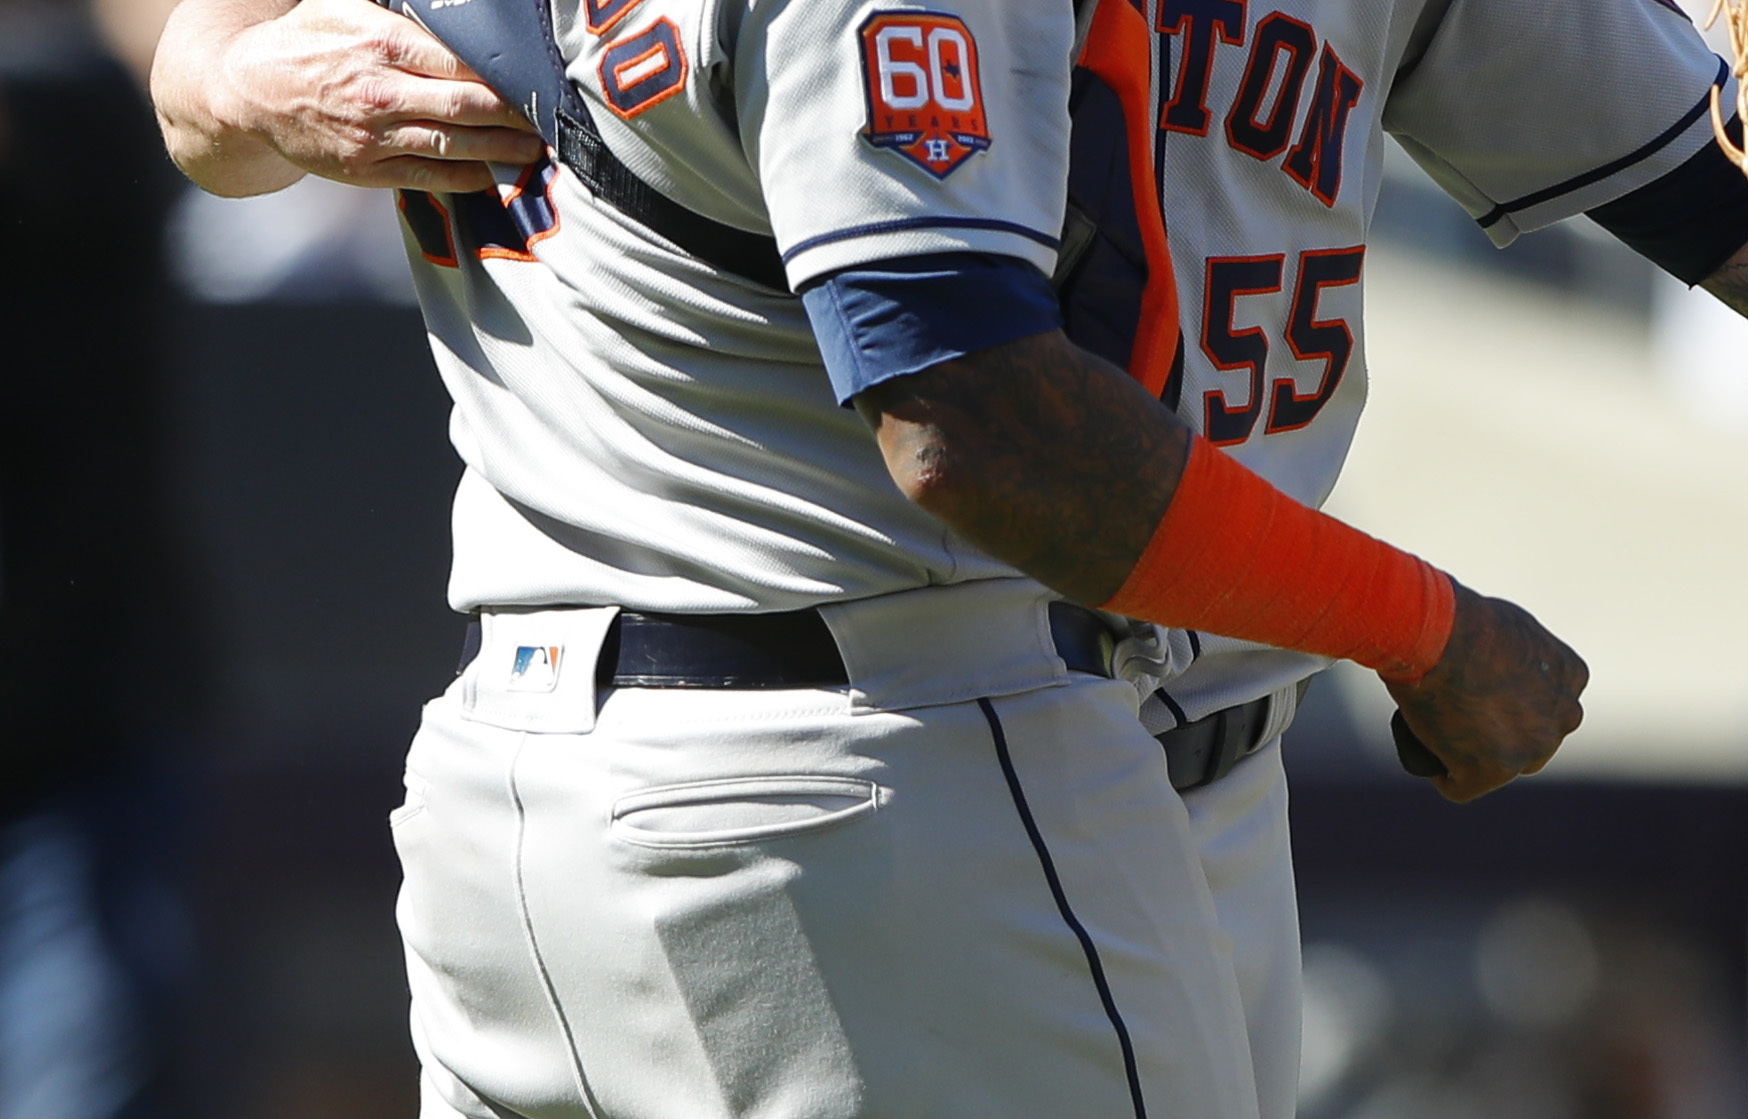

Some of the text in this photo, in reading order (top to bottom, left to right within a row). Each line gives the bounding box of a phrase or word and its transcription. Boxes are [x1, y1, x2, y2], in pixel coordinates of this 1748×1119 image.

[875, 26, 974, 111] 60
[884, 115, 979, 130] YEARS
[925, 139, 950, 161] H
[1200, 244, 1366, 448] 55
